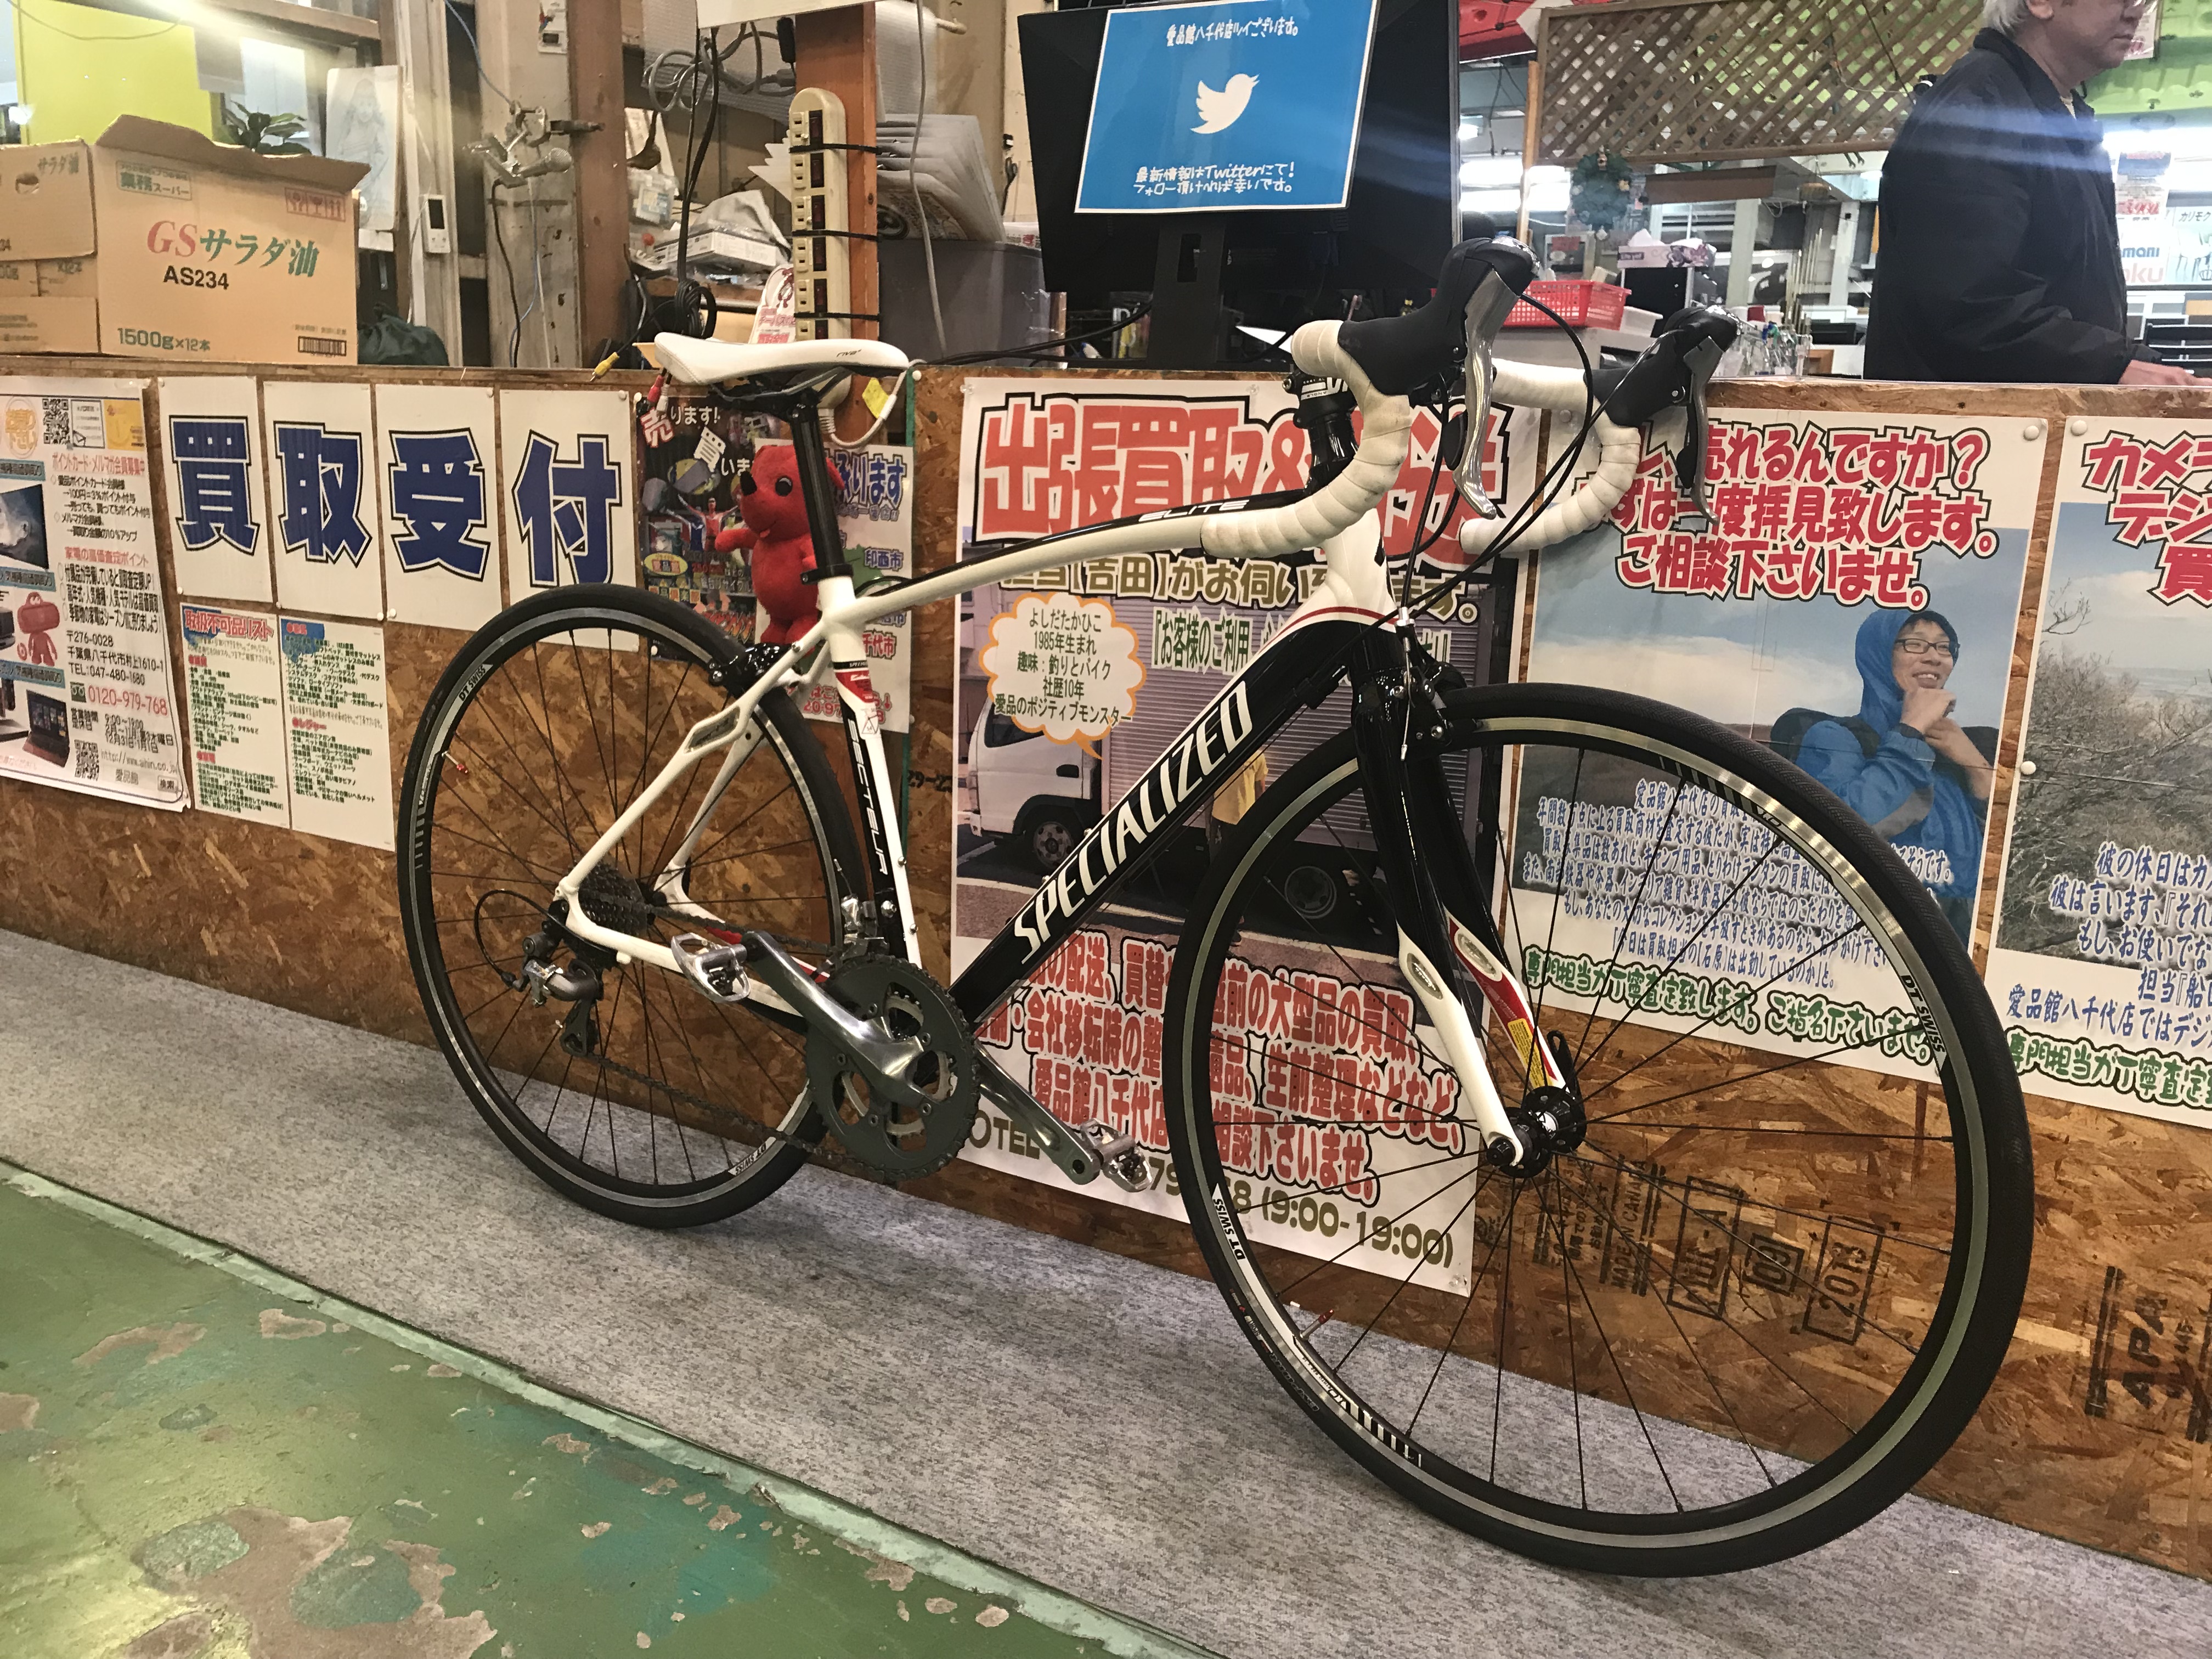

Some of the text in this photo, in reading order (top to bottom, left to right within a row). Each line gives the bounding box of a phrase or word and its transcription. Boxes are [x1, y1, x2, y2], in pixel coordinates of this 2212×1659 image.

[163, 265, 229, 290] AS234
[1138, 498, 1250, 523] ELITE
[865, 549, 904, 572] 印西市
[1621, 538, 1929, 610] ご相談下さいませ。
[184, 609, 273, 641] 取扱不可品リスト
[1029, 607, 1102, 633] よしだたかひこ
[1034, 631, 1097, 656] 1985年生まれ
[459, 664, 487, 702] DT SWISS
[1017, 650, 1111, 680] 趣味:釣りとバイク
[88, 685, 168, 716] 0120-979-768
[1042, 676, 1084, 701] 社歴10年
[994, 693, 1132, 727] 愛品のポジティブモンスター
[847, 718, 888, 876] SECTEUR
[1014, 680, 1254, 964] SPECIALIZED
[2050, 876, 2212, 928] 彼は言います、『それ
[1526, 948, 1758, 1030] 専門担当が丁寧査定致します。
[1770, 995, 1927, 1061] ご指名下さいませ。
[1900, 974, 1945, 1053] DT SWISS
[2010, 1031, 2212, 1107] 専門担当が丁寧査定
[1213, 1198, 1245, 1261] DT SWISS
[1261, 1186, 1454, 1269] (9:00-19:00)
